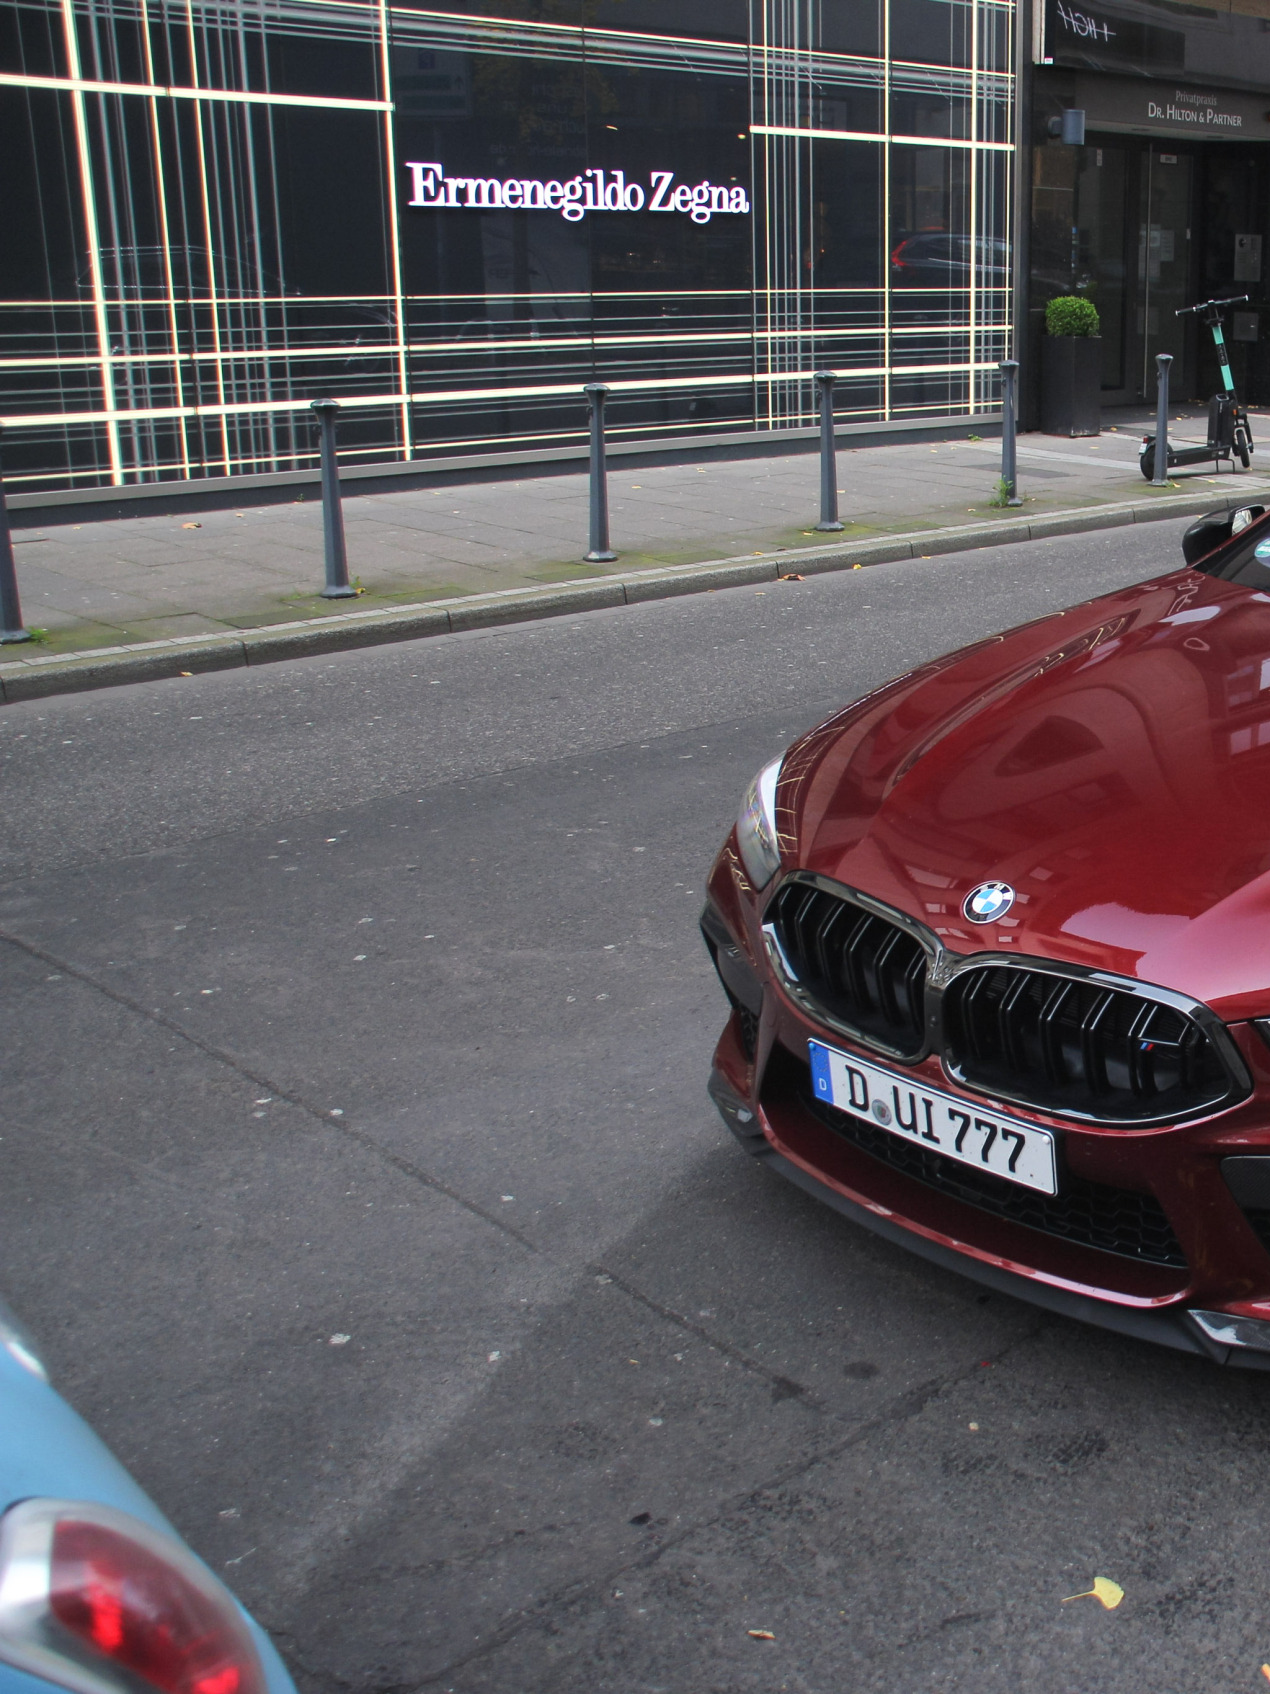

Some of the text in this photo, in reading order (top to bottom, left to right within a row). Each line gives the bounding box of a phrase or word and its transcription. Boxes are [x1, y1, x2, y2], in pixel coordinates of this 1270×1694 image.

[1175, 90, 1218, 106] Privatpraxis
[1198, 113, 1204, 123] &
[404, 161, 750, 225] Ermenegildo Zegna
[818, 1077, 827, 1091] D
[845, 1064, 1026, 1173] D UI 777
